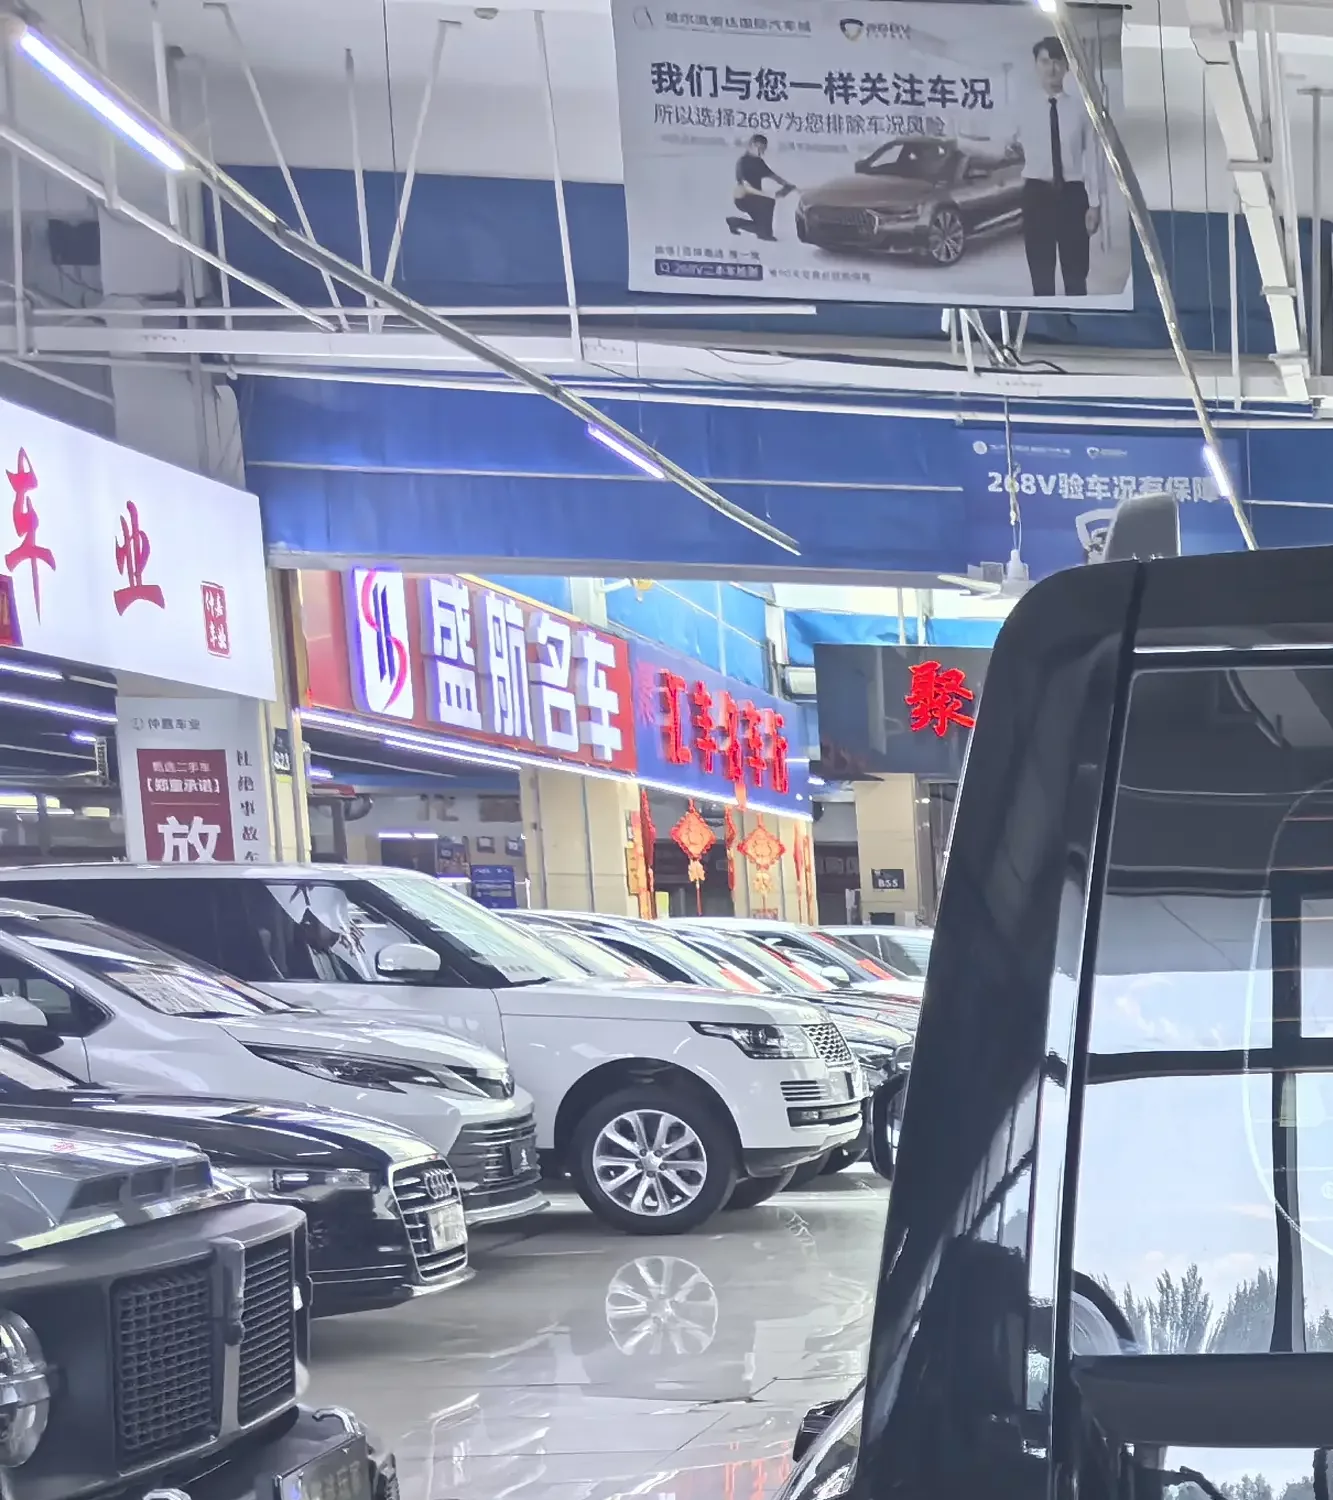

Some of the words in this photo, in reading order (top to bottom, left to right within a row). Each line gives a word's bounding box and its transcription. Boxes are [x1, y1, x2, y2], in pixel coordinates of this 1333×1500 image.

[650, 61, 994, 110] 我们与您一样关注车况
[653, 102, 946, 137] 所以选择268V为您排除车况风险
[4, 446, 166, 626] 车业
[420, 576, 622, 763] 盛航名车
[905, 660, 976, 738] 聚
[157, 815, 222, 862] 放
